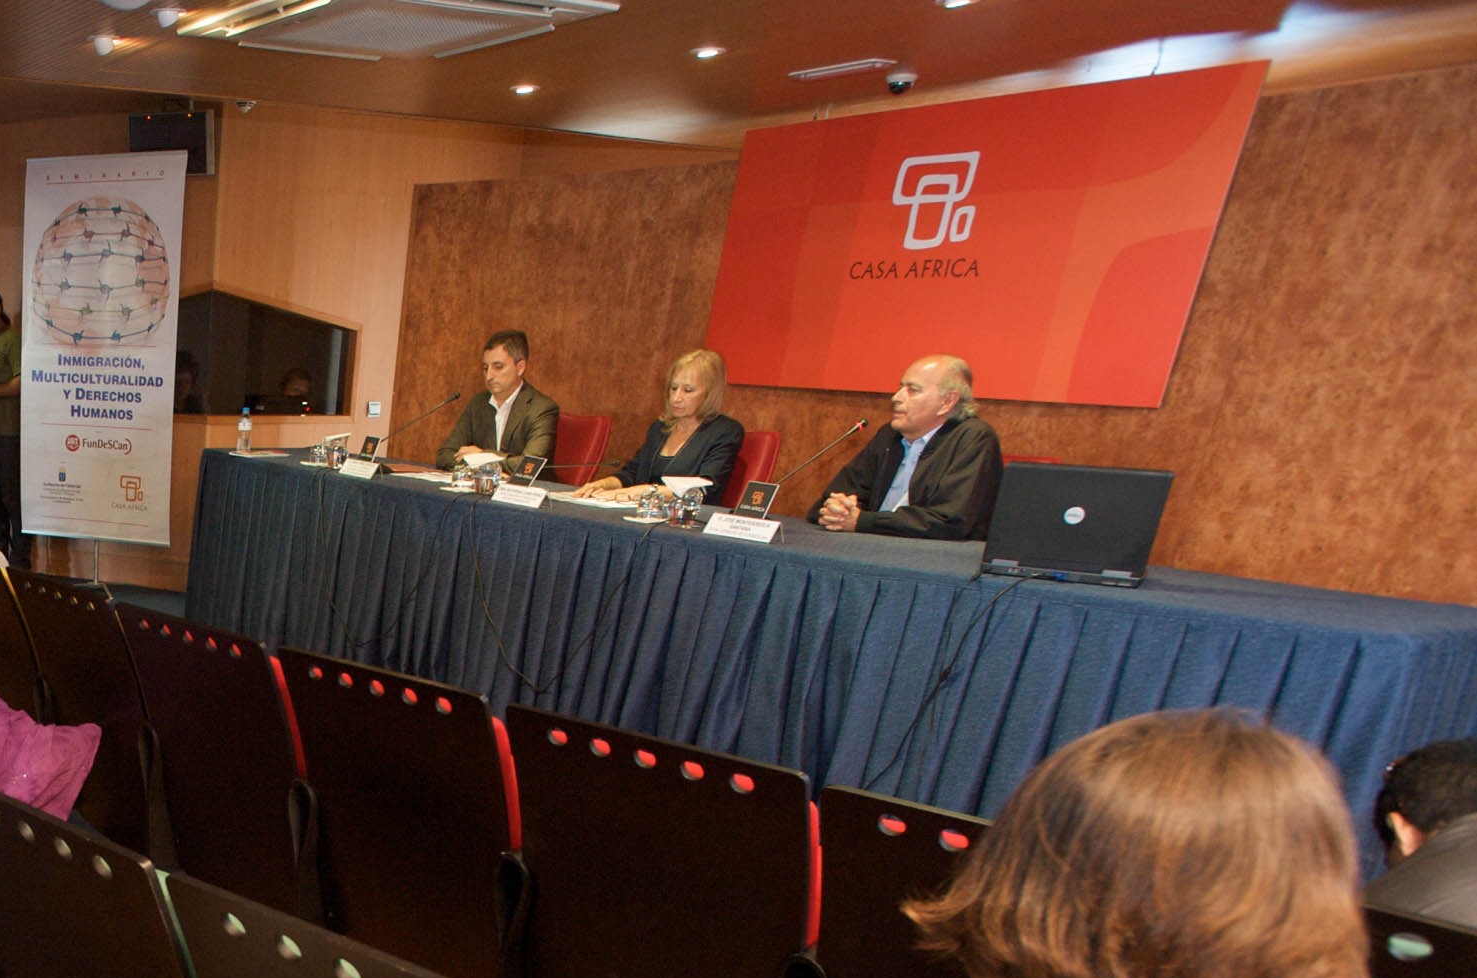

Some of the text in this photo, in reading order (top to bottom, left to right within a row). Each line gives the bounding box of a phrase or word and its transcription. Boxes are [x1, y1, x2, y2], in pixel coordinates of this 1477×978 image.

[849, 258, 980, 279] CASA AFRICA
[31, 370, 164, 387] MULTICULTURALIDAD
[75, 388, 142, 403] DERECHOS
[70, 405, 133, 420] HUMANOS
